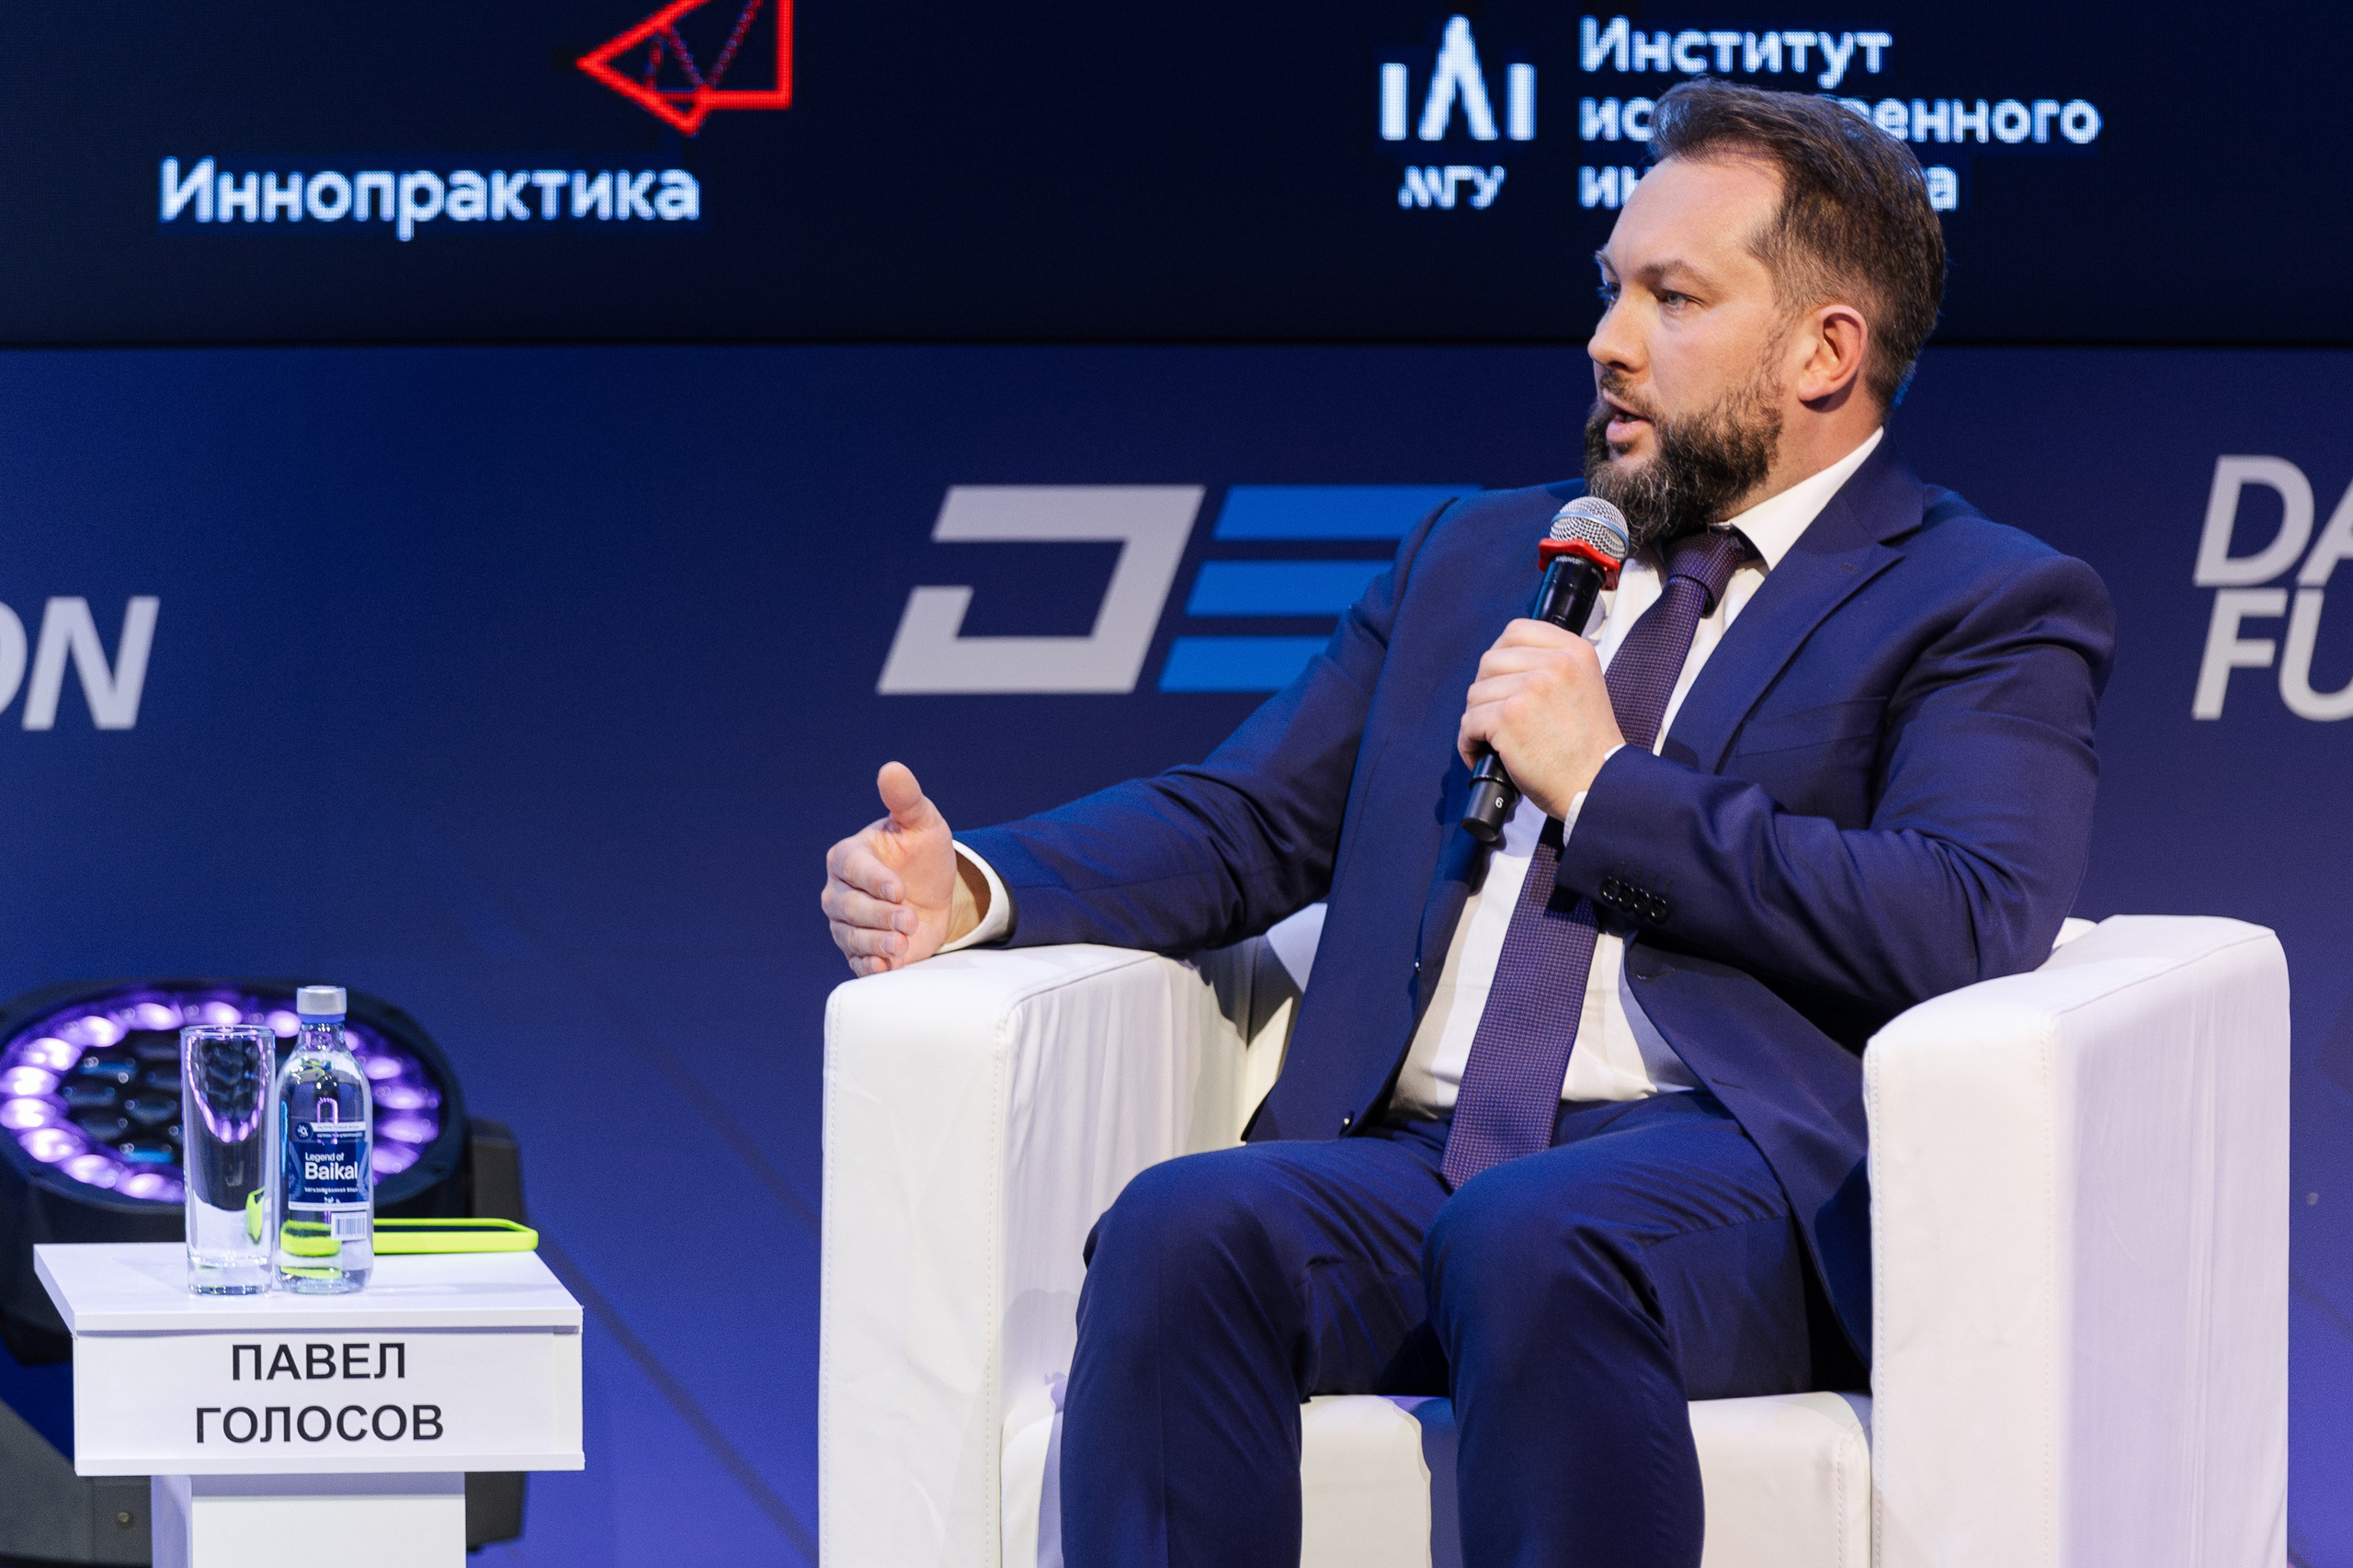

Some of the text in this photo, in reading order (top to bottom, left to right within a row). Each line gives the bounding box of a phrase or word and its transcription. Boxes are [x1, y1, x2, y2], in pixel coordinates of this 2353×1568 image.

[1580, 15, 1893, 89] Институт
[1579, 96, 2103, 144] исенного
[159, 155, 700, 243] Иннопрактика
[1397, 164, 1506, 210] МГУ
[0, 595, 161, 732] N
[2191, 588, 2353, 722] FU
[1495, 796, 1504, 809] 6
[304, 1152, 345, 1164] Legend of
[304, 1161, 358, 1181] Baikal
[232, 1342, 405, 1381] ПАВЕЛ
[196, 1403, 444, 1444] ГОЛОСОВ
